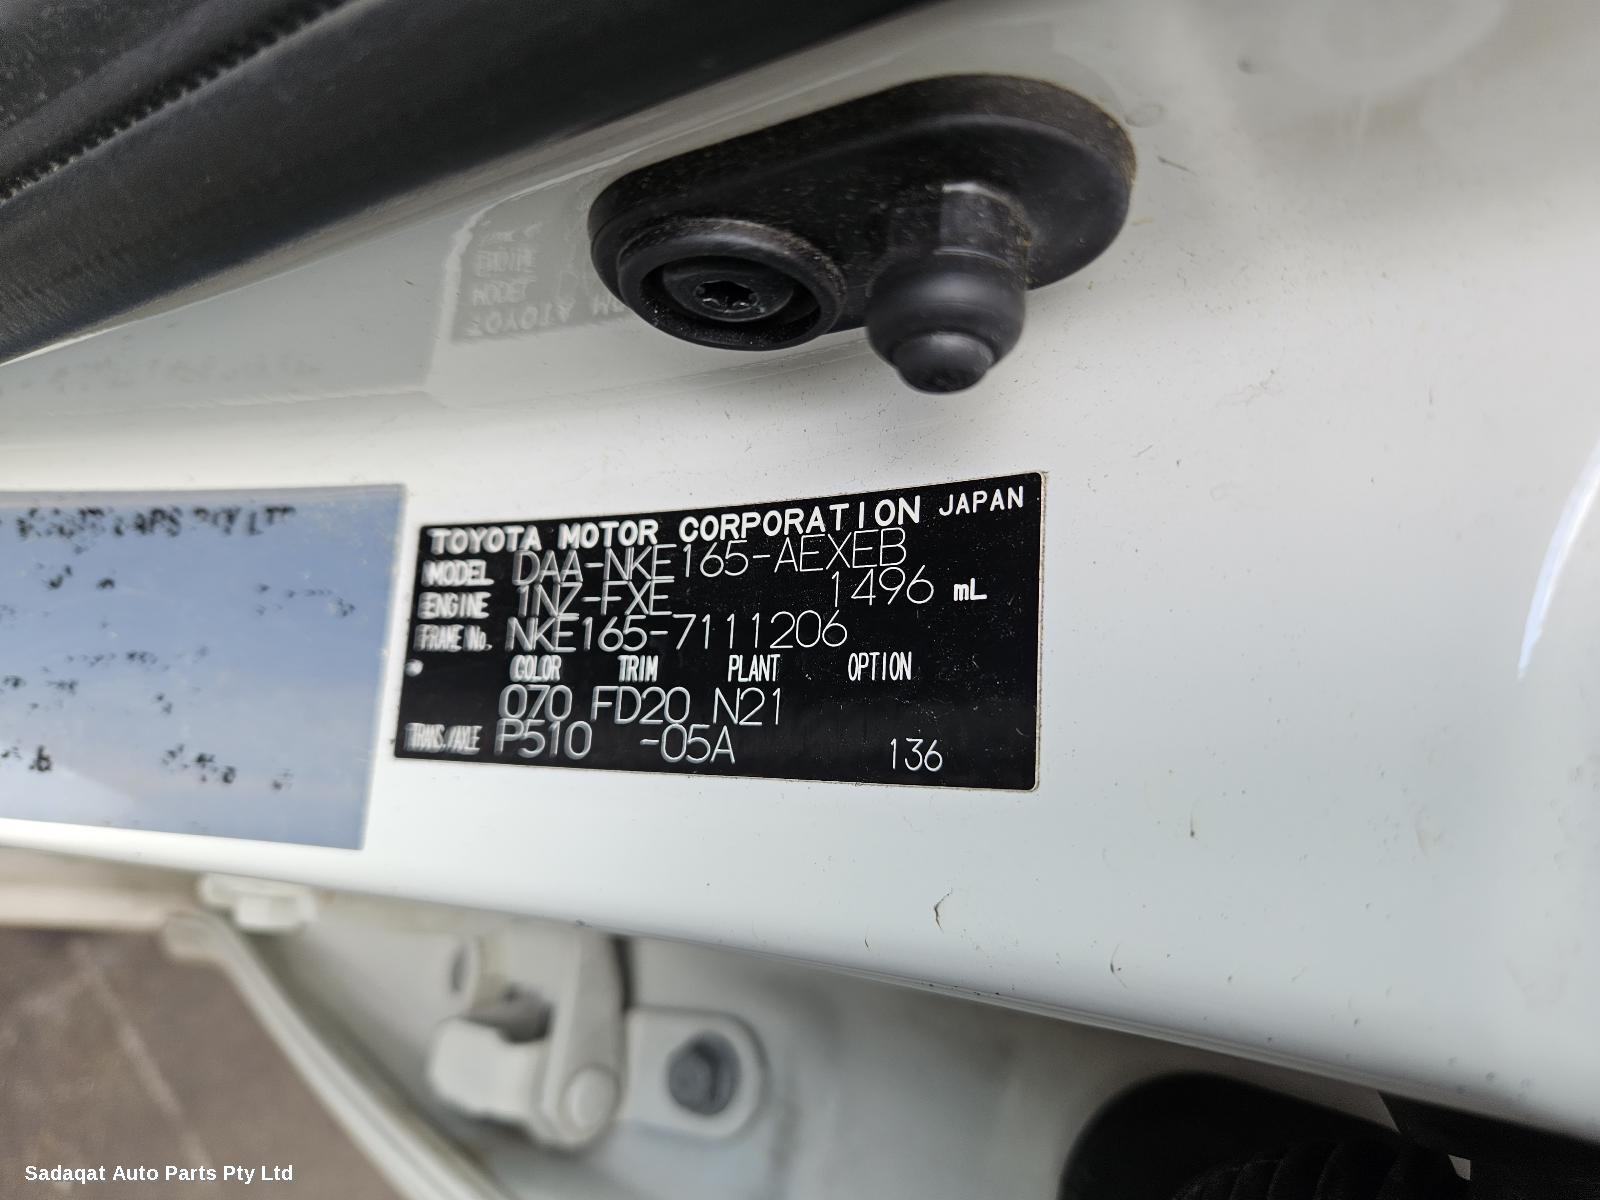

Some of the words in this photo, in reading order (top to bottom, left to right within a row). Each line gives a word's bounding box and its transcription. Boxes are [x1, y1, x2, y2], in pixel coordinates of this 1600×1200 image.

[428, 524, 541, 555] TOYOTA
[557, 518, 659, 550] MOTOR
[678, 495, 921, 543] CORPORATION
[938, 485, 1024, 516] JAPAN
[421, 559, 495, 587] MODEL
[511, 526, 908, 586] DAA-NKE165-AEXEB
[417, 591, 492, 619] ENGINE
[516, 578, 673, 618] 1NZ-FXE
[831, 565, 935, 608] 1496
[953, 577, 988, 601] mL
[413, 623, 464, 653] FRAME
[504, 609, 848, 654] NKE165-7111206
[509, 654, 563, 682] COLOR
[618, 654, 660, 683] TRIM
[727, 653, 781, 682] PLANT
[848, 651, 913, 682] OPTION
[591, 685, 691, 725] FD20
[712, 686, 782, 726] N21
[494, 718, 593, 761] P510
[890, 737, 944, 773] 136
